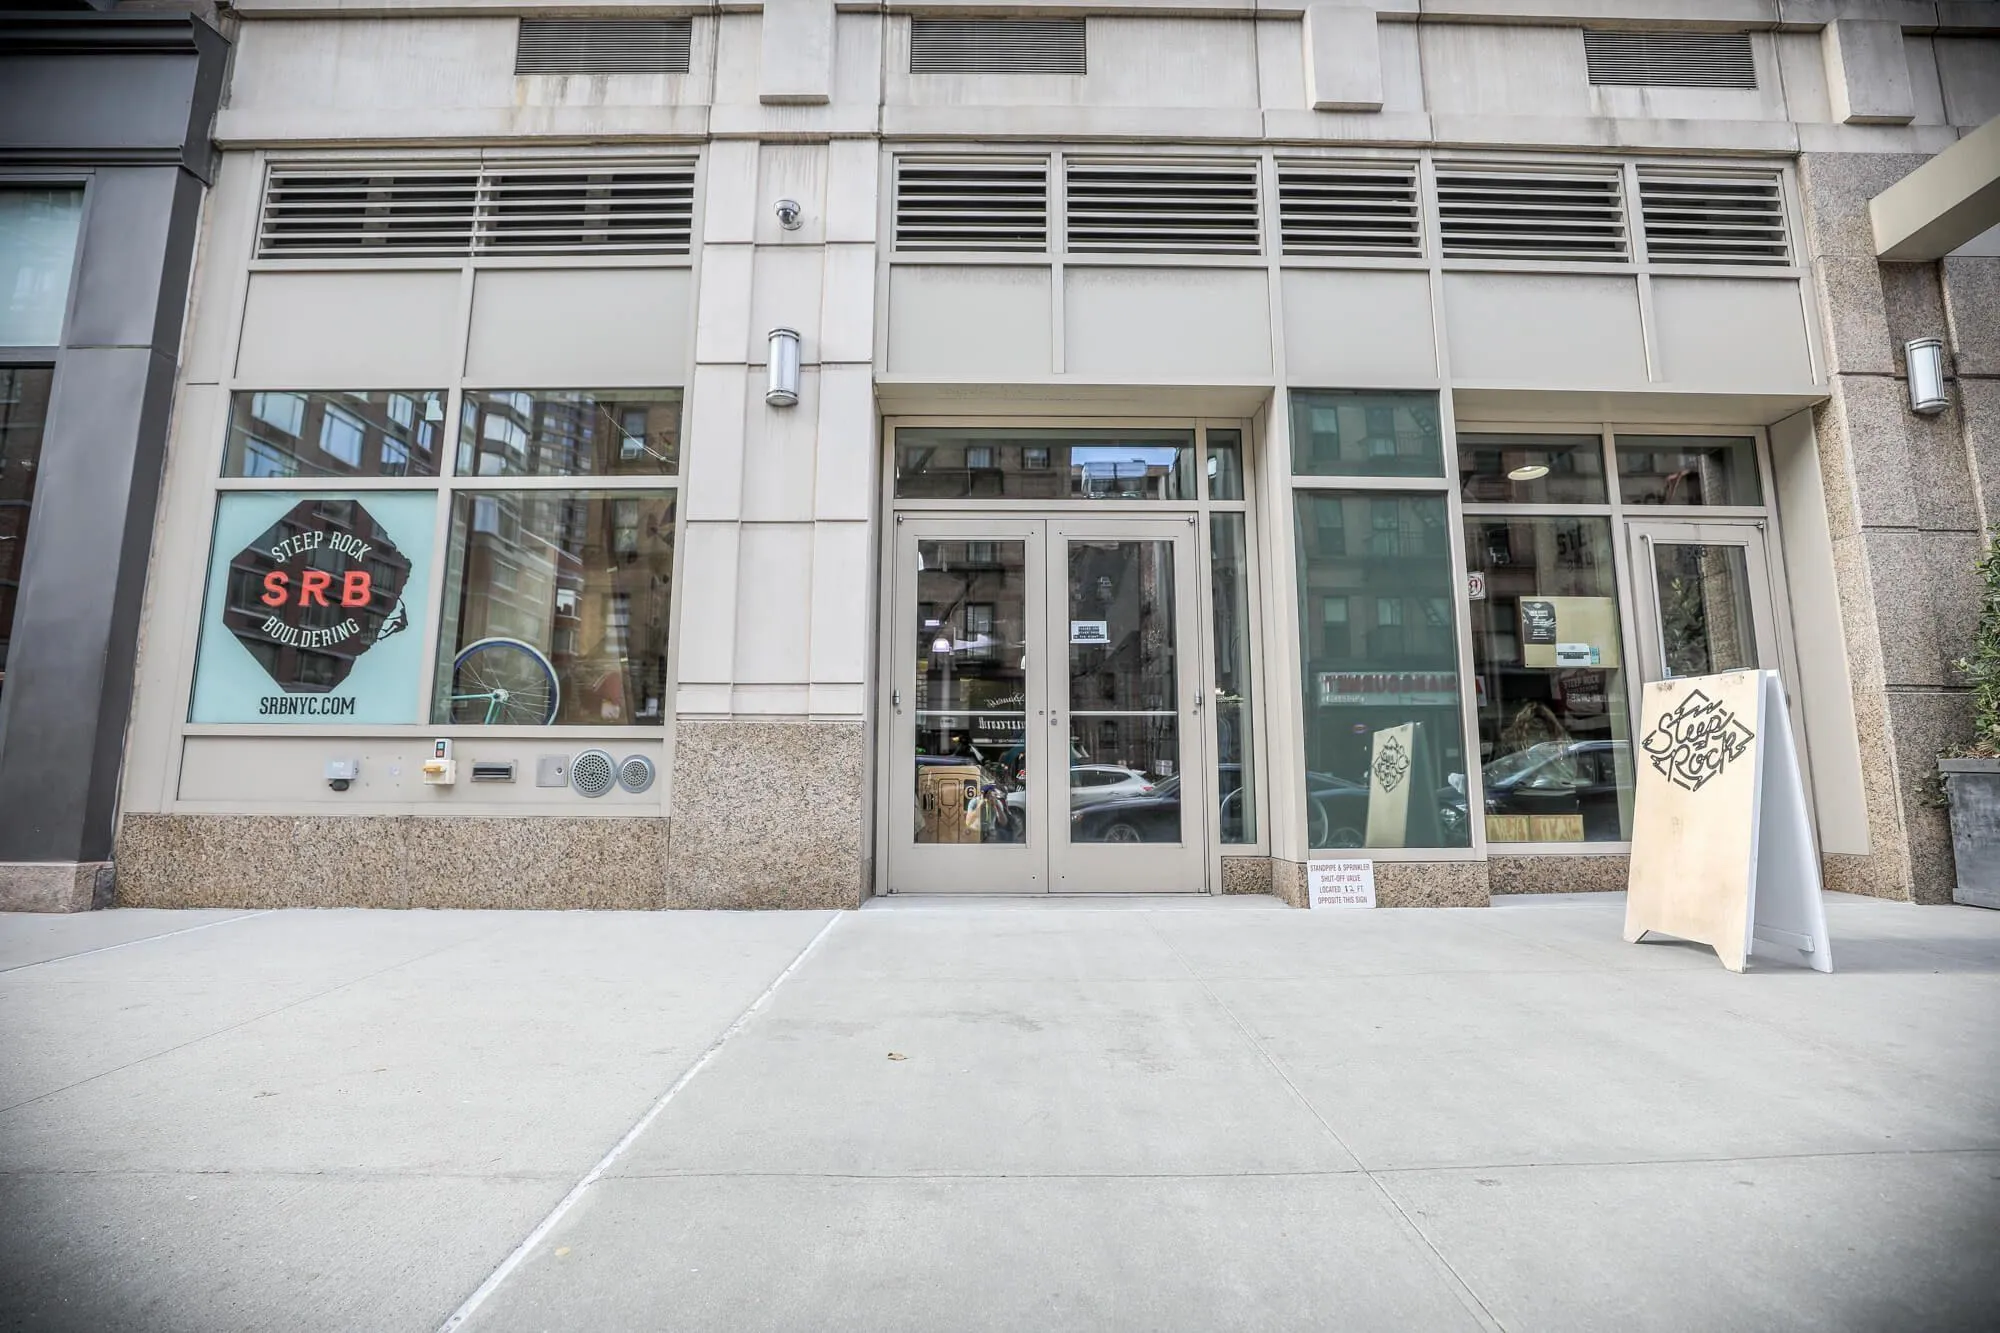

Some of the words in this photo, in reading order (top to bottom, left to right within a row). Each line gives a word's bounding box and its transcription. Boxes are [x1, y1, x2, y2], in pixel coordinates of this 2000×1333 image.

[271, 531, 324, 563] STEEP
[328, 531, 373, 562] ROCK
[261, 571, 372, 607] SRB
[261, 615, 361, 648] BOULDERING
[259, 696, 356, 715] SRBNYC.COM
[1642, 700, 1735, 754] Steep
[1651, 731, 1746, 782] Rock
[966, 786, 975, 798] 6
[1310, 864, 1337, 872] STANDPIPE
[1338, 864, 1342, 872] &
[1343, 863, 1370, 871] SPRINKLER
[1320, 875, 1345, 883] SHUT-OFF
[1347, 874, 1361, 882] VALVE
[1317, 896, 1342, 904] OPPOSITE
[1343, 896, 1355, 904] THIS
[1356, 896, 1368, 904] SIGN
